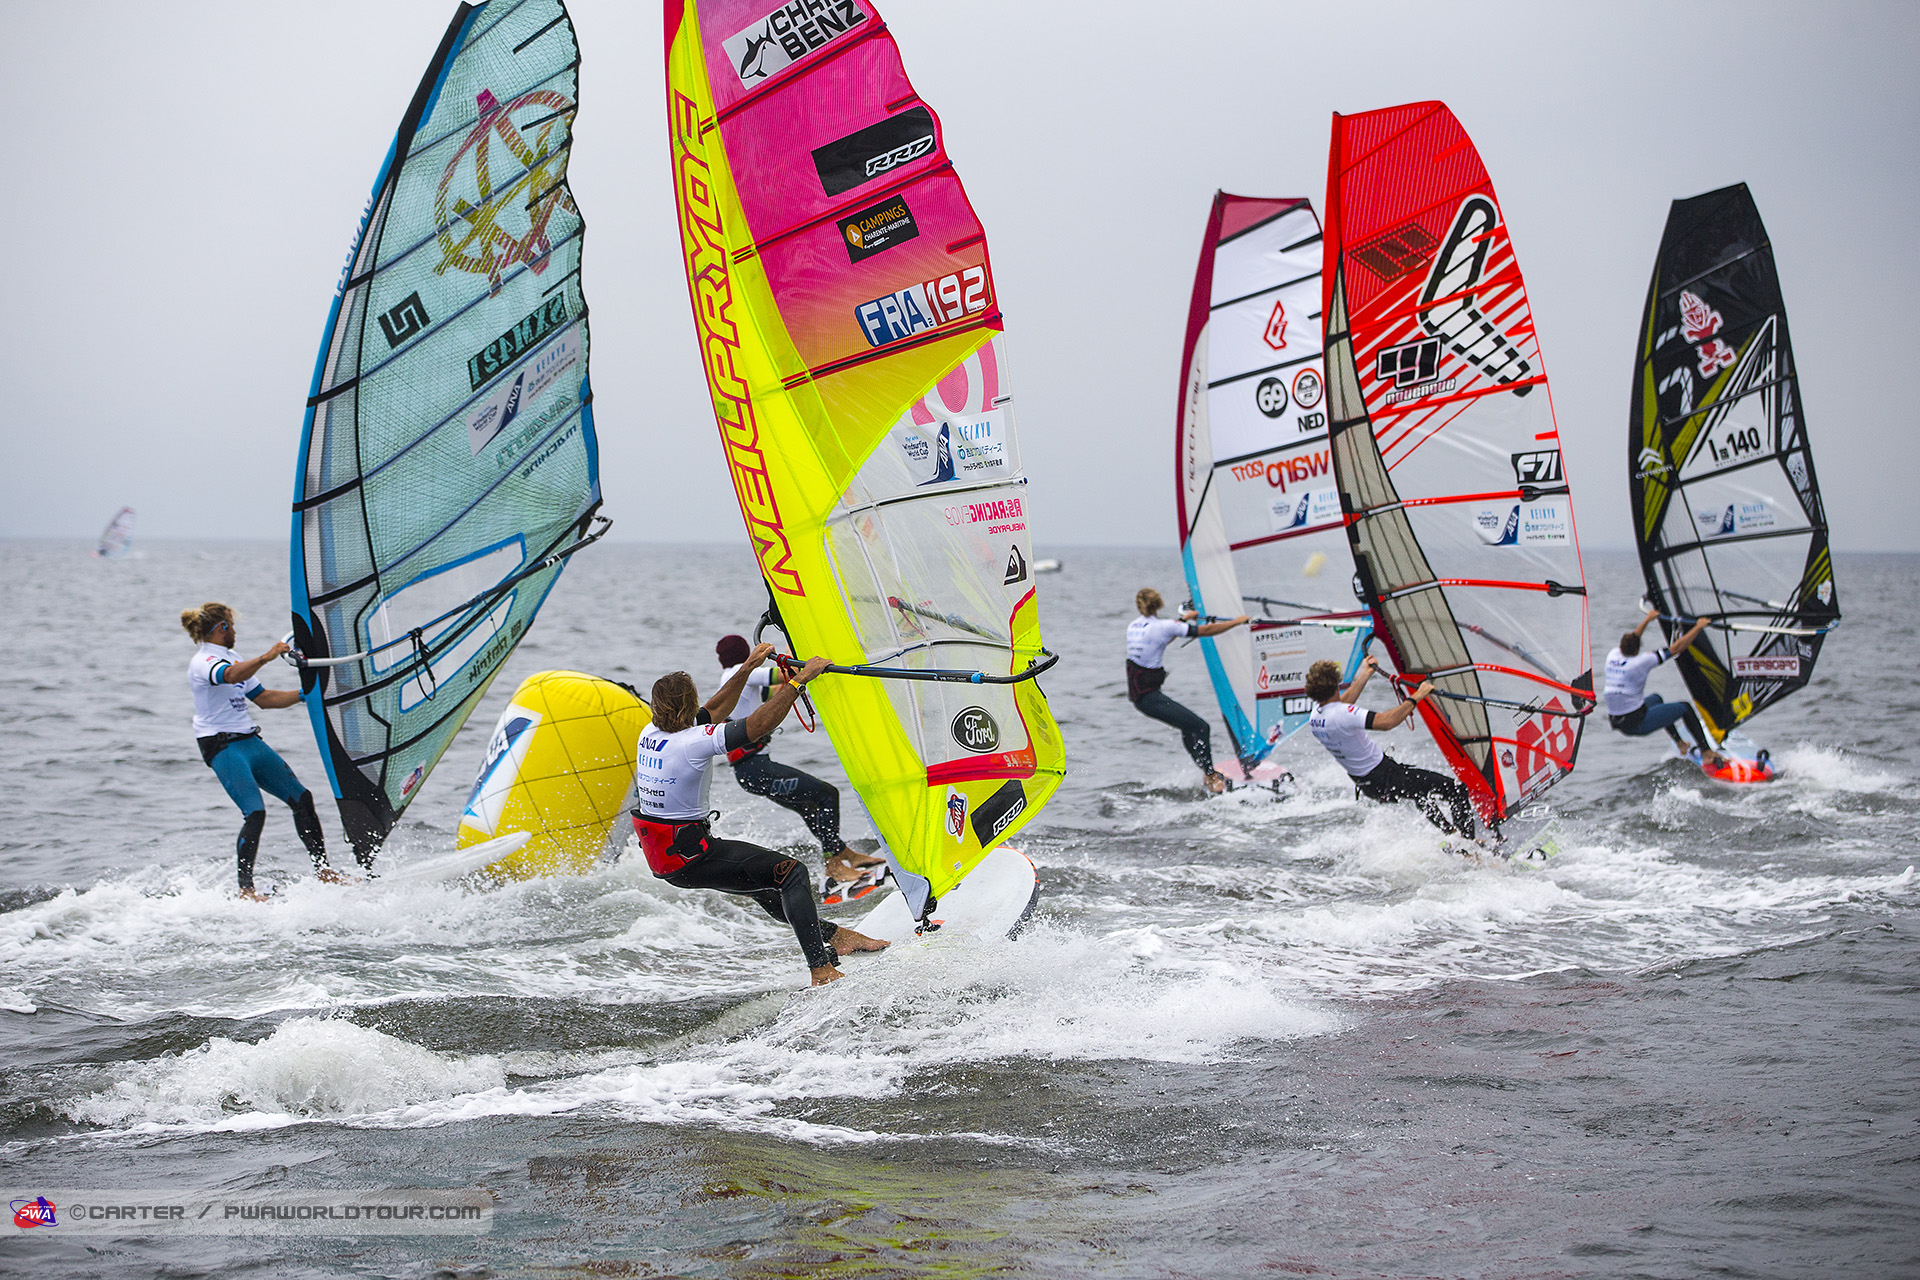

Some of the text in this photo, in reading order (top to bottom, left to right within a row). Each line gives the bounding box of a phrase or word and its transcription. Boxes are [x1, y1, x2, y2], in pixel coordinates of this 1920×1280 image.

[779, 0, 866, 60] BENZ
[865, 135, 933, 177] RRD
[860, 205, 906, 232] CAMPINGS
[864, 217, 910, 241] CHARENTE-MARITIME
[860, 289, 929, 345] FRA
[926, 266, 986, 323] 192
[507, 385, 521, 414] ANA
[1258, 383, 1286, 412] 69
[958, 421, 991, 441] KEIKYU
[1298, 412, 1325, 432] NED
[939, 434, 949, 468] ANA
[1727, 427, 1760, 456] 140
[1517, 451, 1558, 481] F71
[1269, 672, 1302, 684] FANATIC
[1737, 660, 1797, 671] STARBOARD
[964, 714, 995, 745] Ford
[639, 737, 657, 752] ANA
[639, 754, 663, 770] KEIKYU
[993, 798, 1024, 837] RRD
